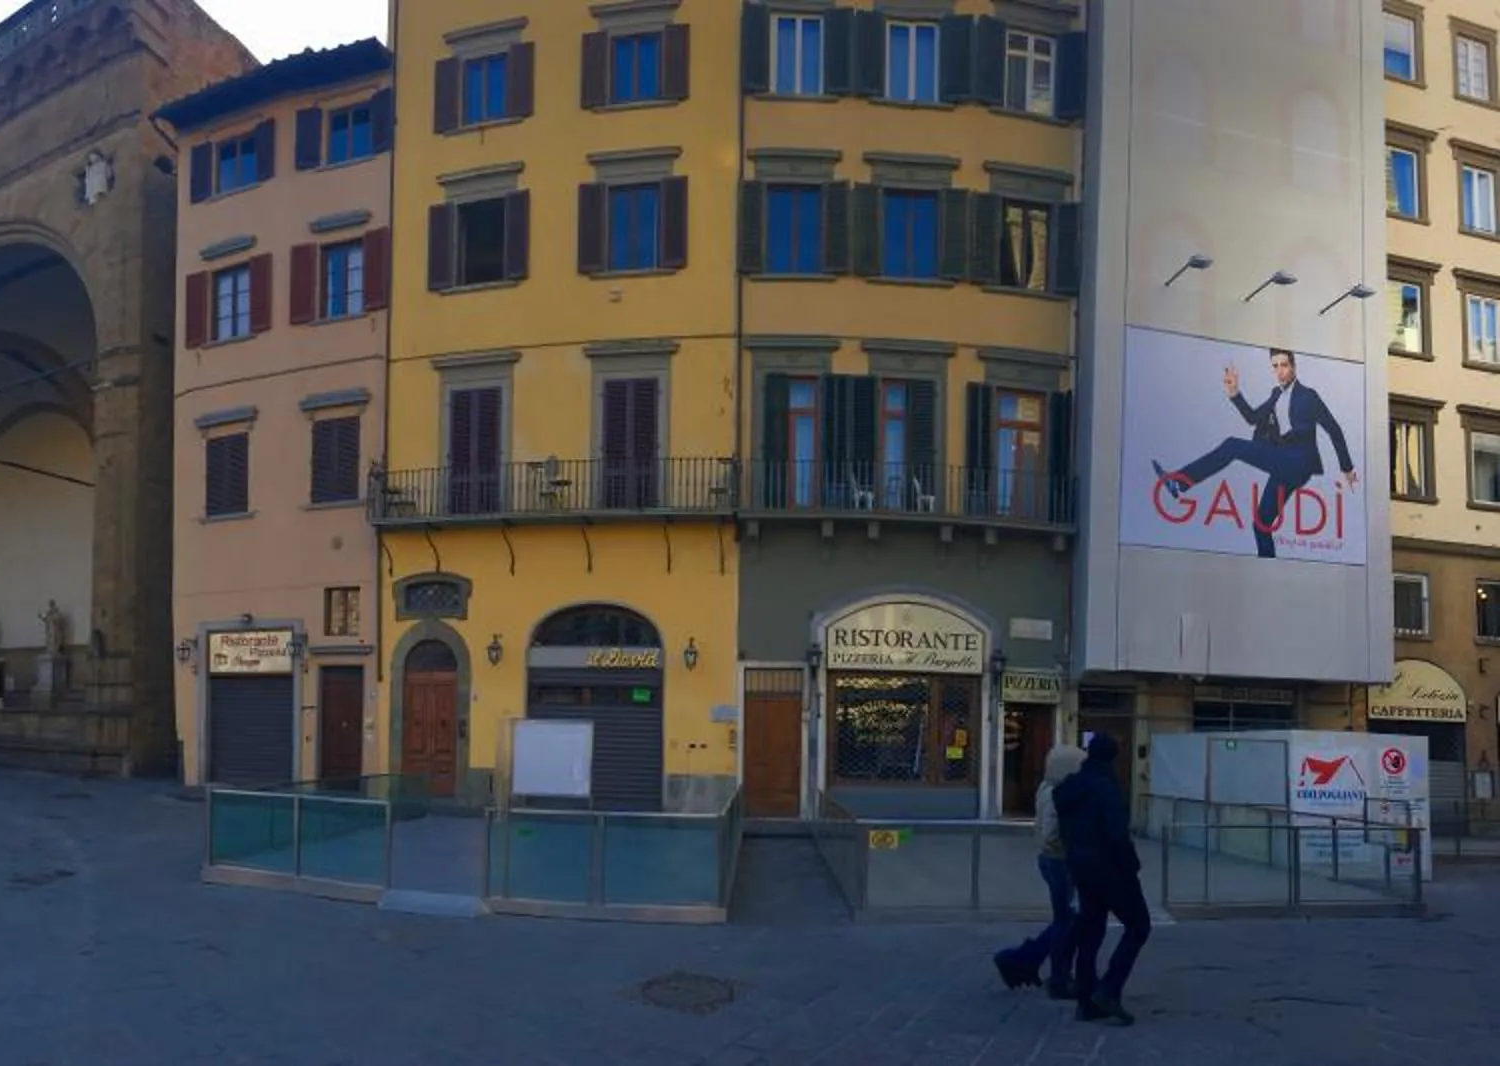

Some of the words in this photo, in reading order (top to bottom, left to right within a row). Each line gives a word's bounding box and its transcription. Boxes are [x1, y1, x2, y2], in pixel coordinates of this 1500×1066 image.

[220, 634, 279, 647] Ristorante
[833, 629, 980, 652] RISTORANTE
[832, 651, 894, 665] PIZZERIA
[1004, 675, 1060, 691] PIZZERIA
[1371, 704, 1463, 720] CAFFETTERIA
